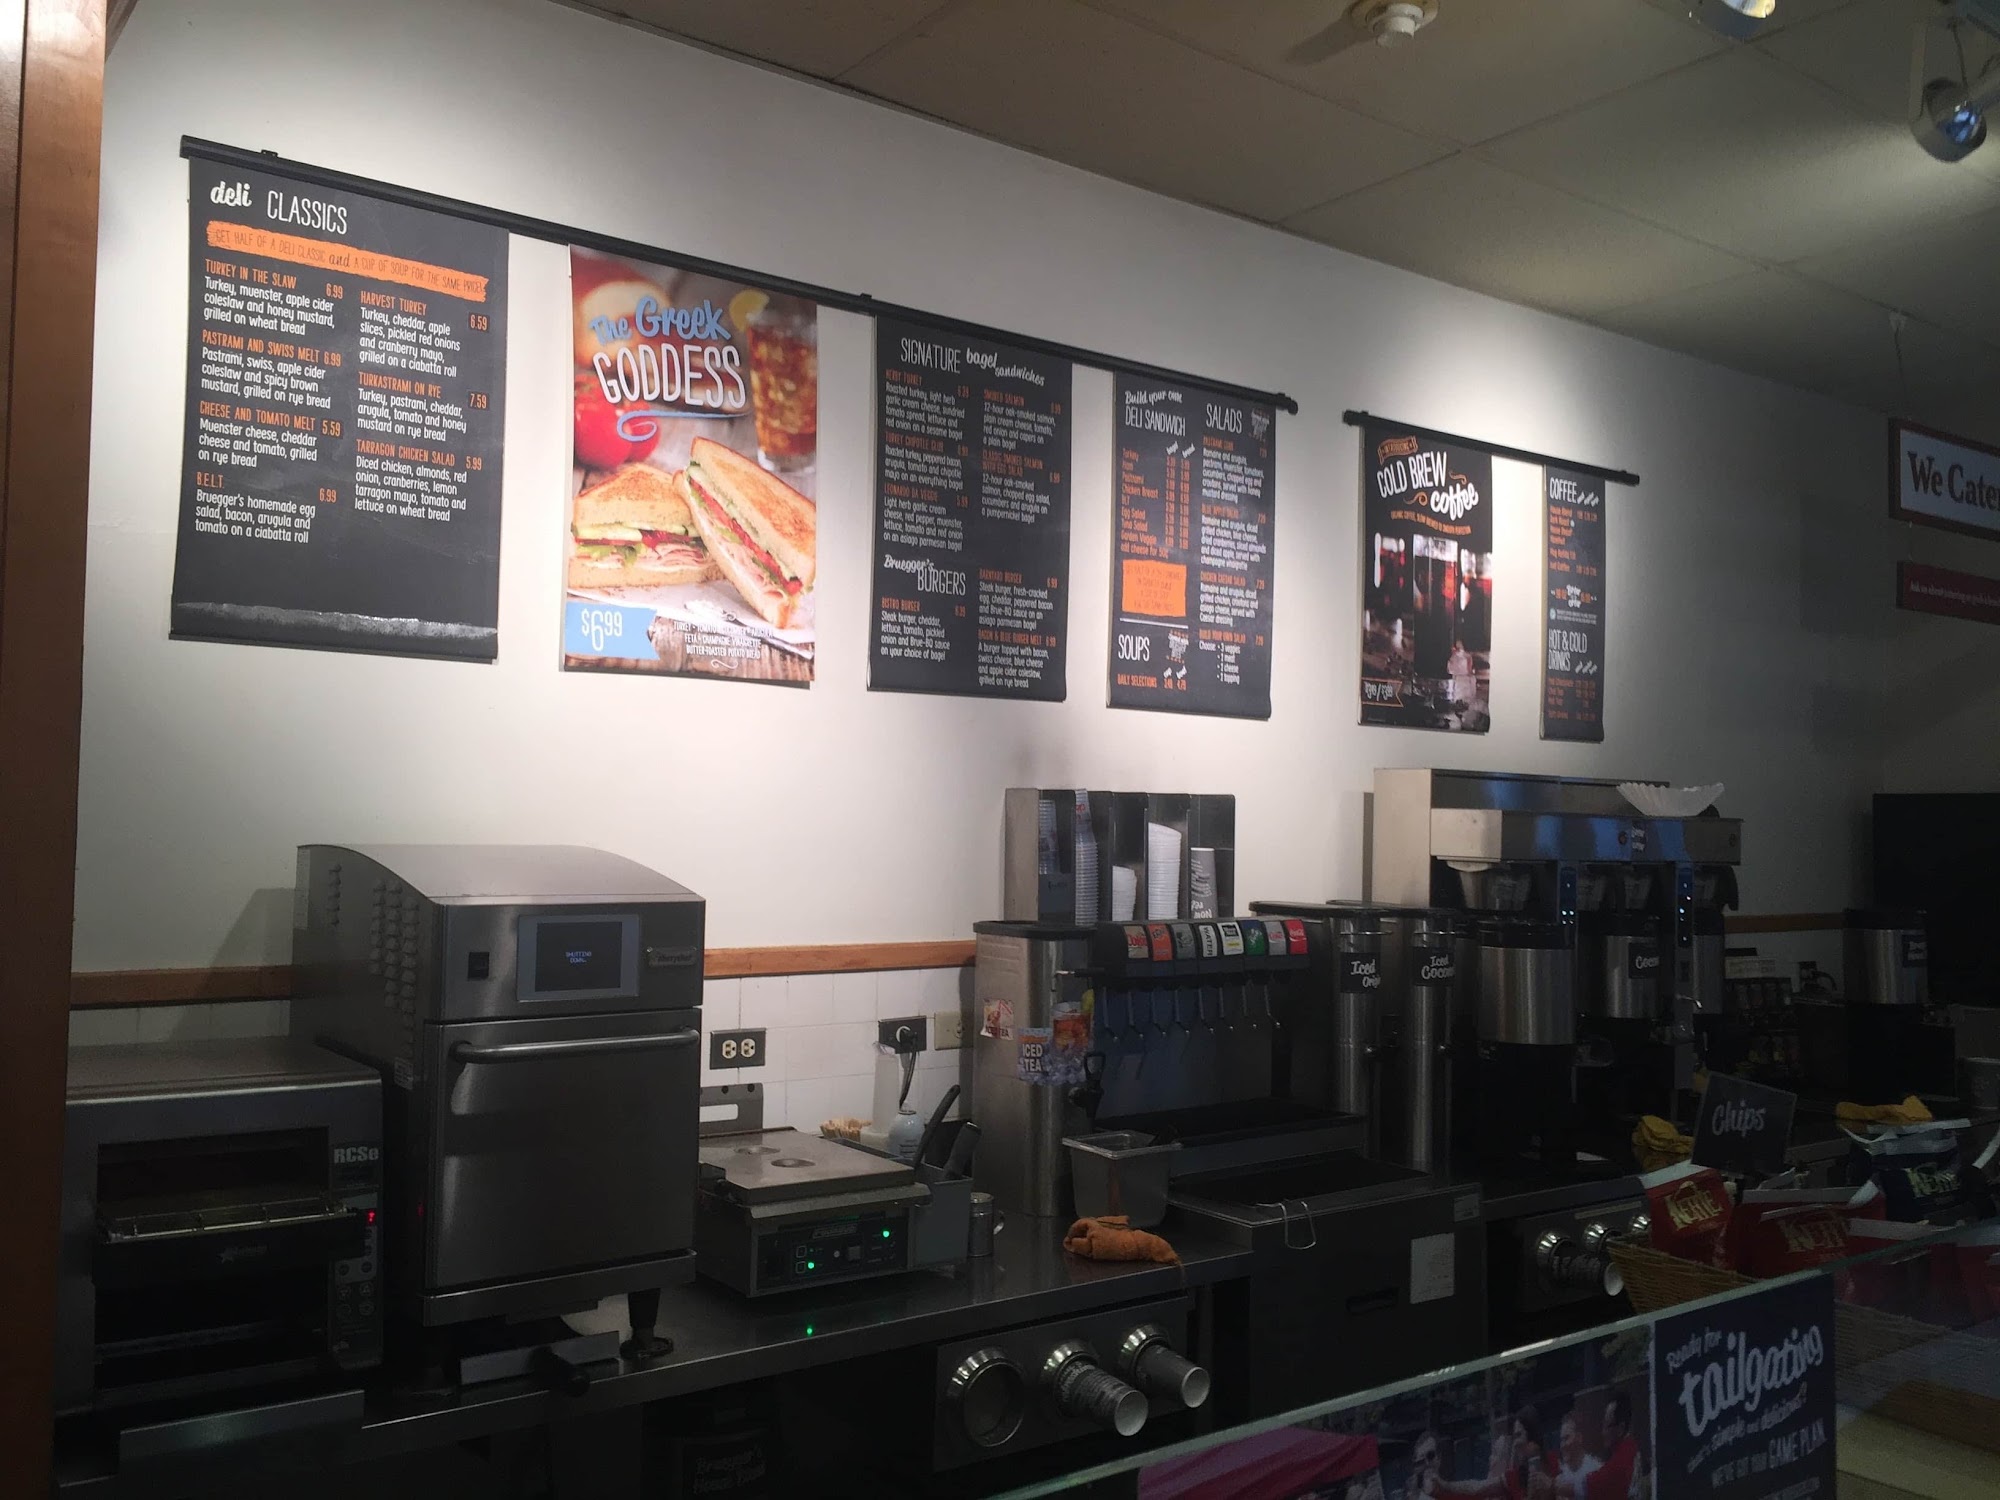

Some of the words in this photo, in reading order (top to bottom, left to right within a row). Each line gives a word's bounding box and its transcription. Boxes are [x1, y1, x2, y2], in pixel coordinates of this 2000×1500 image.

[210, 181, 252, 207] deli
[267, 190, 348, 235] CLASSICS
[204, 258, 237, 278] TURKEY
[239, 265, 248, 280] IN
[252, 268, 268, 284] THE
[271, 272, 296, 289] SLAW
[204, 275, 236, 296] Turkey,
[239, 285, 283, 305] muenster,
[285, 294, 310, 309] apple
[311, 297, 334, 312] cider
[325, 283, 343, 299] 6.99
[360, 290, 395, 310] HARVEST
[399, 298, 427, 316] TURKEY
[203, 292, 243, 310] coleslaw
[246, 300, 264, 314] and
[266, 302, 294, 322] honey
[296, 311, 334, 329] mustard,
[203, 306, 231, 322] grilled
[233, 313, 246, 325] on
[248, 314, 277, 330] wheat
[280, 319, 305, 335] bread
[359, 306, 390, 326] Turkey,
[391, 313, 426, 333] cheddar,
[428, 322, 450, 337] apple
[470, 313, 487, 331] 6.59
[589, 313, 633, 345] The
[635, 295, 731, 341] Greek
[201, 329, 244, 350] PASTRAMI
[247, 337, 264, 353] AND
[267, 341, 294, 358] SWISS
[297, 346, 319, 363] MELT
[323, 351, 341, 366] 6.99
[359, 321, 385, 339] slices,
[387, 326, 416, 342] pickled
[418, 333, 432, 345] red
[434, 336, 460, 351] onions
[201, 346, 244, 367] Pastrami,
[246, 356, 274, 372] swiss,
[276, 361, 302, 377] apple
[303, 364, 326, 379] cider
[592, 343, 746, 409] GODDESS
[901, 337, 961, 374] SIGNATURE
[966, 347, 998, 370] bagel
[995, 364, 1045, 387] sandwiches
[201, 363, 241, 380] coleslaw
[243, 370, 261, 383] and
[264, 373, 288, 390] spicy
[290, 376, 318, 392] brown
[358, 371, 411, 393] TURKASTRAMI
[414, 381, 425, 395] ON
[427, 383, 441, 398] RYE
[200, 379, 240, 397] mustard,
[242, 384, 271, 399] grilled
[273, 391, 285, 402] on
[288, 393, 303, 407] rye
[306, 393, 331, 409] bread
[469, 392, 486, 408] 7.59
[1124, 390, 1148, 405] Build
[1149, 391, 1167, 406] your
[199, 401, 230, 419] CHEESE
[234, 406, 251, 422] AND
[255, 409, 290, 428] TOMATO
[293, 415, 315, 431] MELT
[321, 419, 341, 436] 5.59
[1125, 405, 1143, 428] DELI
[1144, 410, 1186, 437] SANDWICH
[1206, 403, 1243, 434] SALADS
[198, 417, 242, 436] Muenster
[244, 424, 279, 443] cheese,
[280, 430, 317, 446] cheddar
[197, 450, 209, 460] on
[212, 452, 228, 465] rye
[230, 451, 257, 467] bread
[198, 433, 230, 449] cheese
[232, 438, 250, 452] and
[252, 440, 287, 459] tomato,
[289, 446, 317, 461] grilled
[355, 439, 395, 457] TARRAGON
[398, 445, 429, 462] CHICKEN
[431, 450, 455, 466] SALAD
[465, 455, 482, 470] 5.99
[1377, 460, 1408, 498] COLD
[1408, 451, 1447, 489] BREW
[1907, 451, 1943, 497] We
[195, 488, 244, 508] Bruegger's
[247, 495, 297, 513] homemade
[299, 504, 315, 518] egg
[319, 487, 337, 503] 6.99
[1430, 482, 1479, 521] coffee
[1549, 477, 1577, 504] COFFEE
[194, 518, 228, 534] tomato
[230, 525, 242, 536] on
[245, 527, 252, 537] a
[254, 525, 291, 541] ciabatta
[293, 530, 308, 543] roll
[195, 505, 222, 521] salad,
[224, 507, 255, 525] bacon,
[257, 514, 291, 528] arugula
[293, 516, 310, 529] and
[884, 554, 934, 573] Bruegger's
[917, 568, 966, 596] BURGERS
[1118, 634, 1150, 662] SOUPS
[1548, 628, 1562, 651] HOT
[1562, 629, 1569, 652] &
[1569, 631, 1588, 654] COLD
[1548, 649, 1571, 672] DRINKS
[1203, 927, 1213, 956] WATER
[1350, 958, 1375, 976] Iced
[1430, 955, 1449, 968] Iced
[1022, 1043, 1043, 1058] ICED
[1024, 1058, 1042, 1073] TEA
[1711, 1099, 1766, 1138] Chips
[333, 1146, 379, 1163] RCSe
[1678, 1325, 1824, 1436] tailgating
